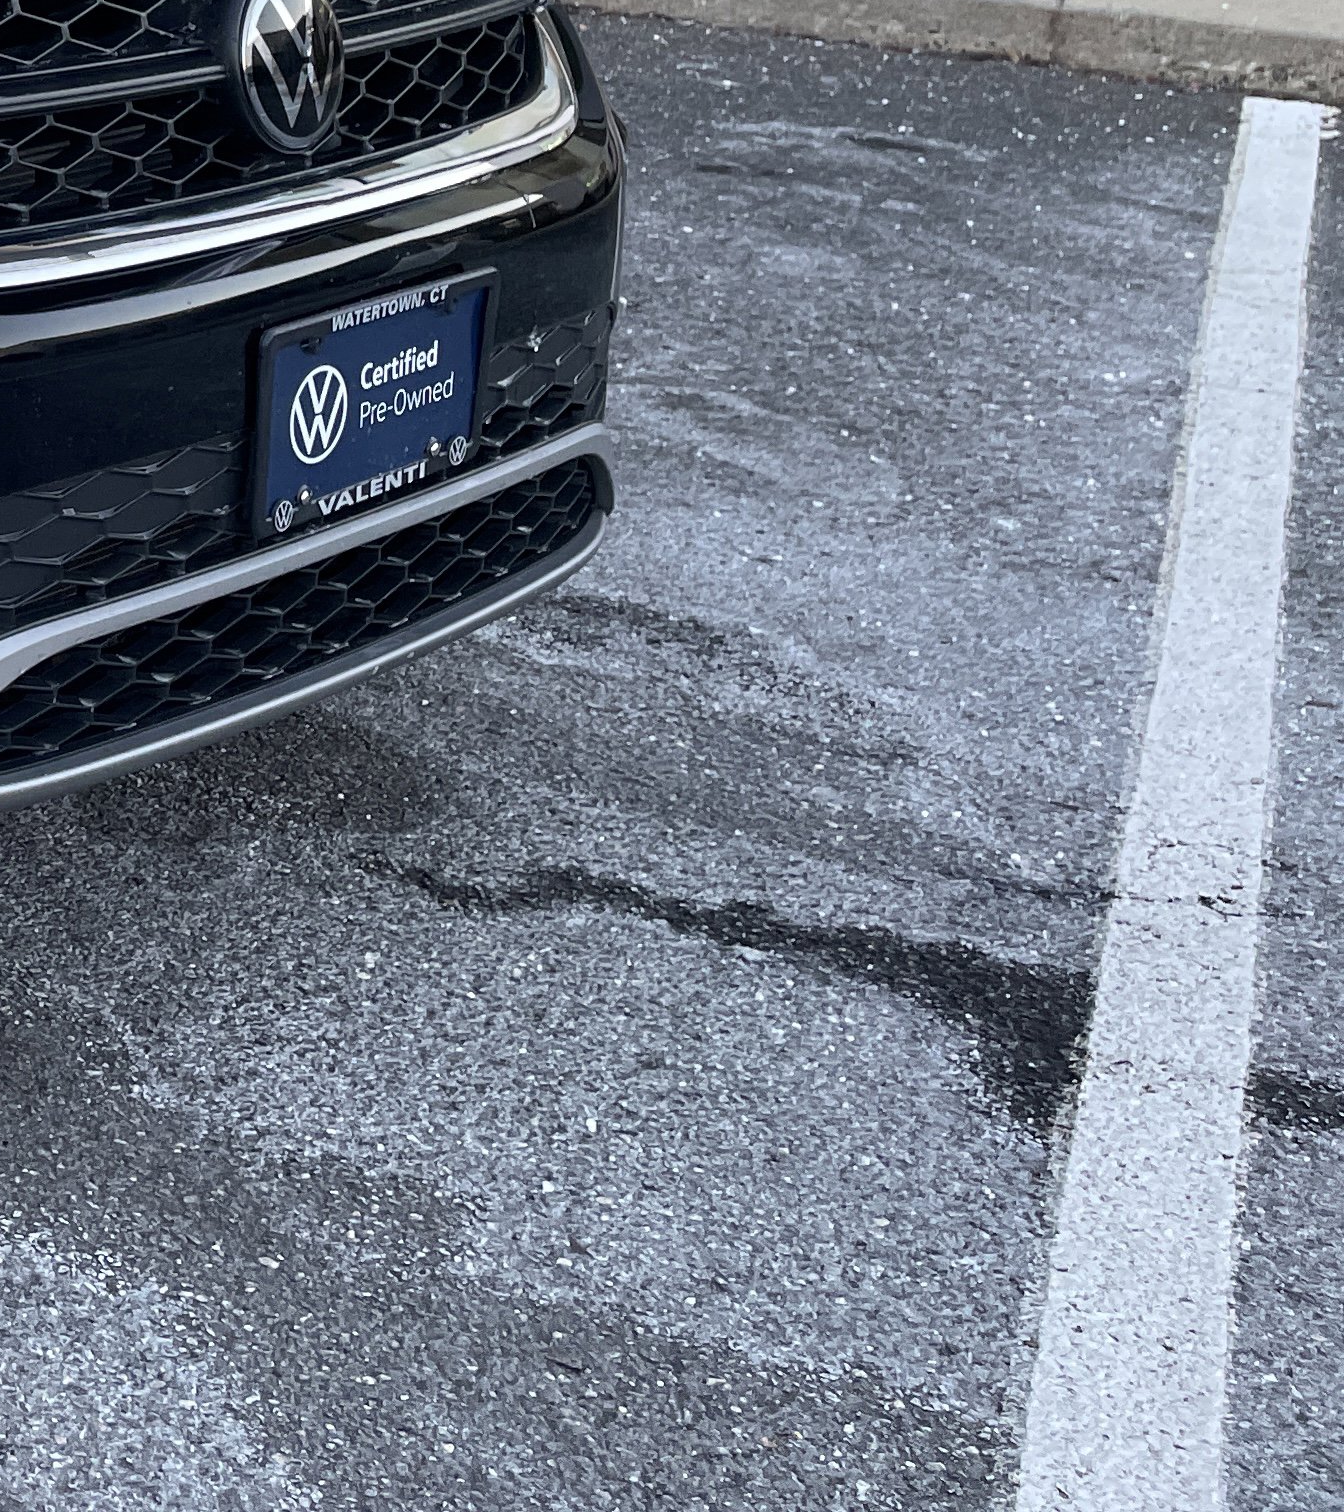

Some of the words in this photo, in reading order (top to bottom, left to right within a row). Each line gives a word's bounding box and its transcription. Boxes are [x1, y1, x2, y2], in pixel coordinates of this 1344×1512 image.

[331, 290, 425, 333] WATERTOWN,
[429, 284, 449, 304] CT
[360, 340, 439, 390] Certified
[359, 371, 454, 429] Pre-Owned
[318, 461, 428, 516] VALENTI
